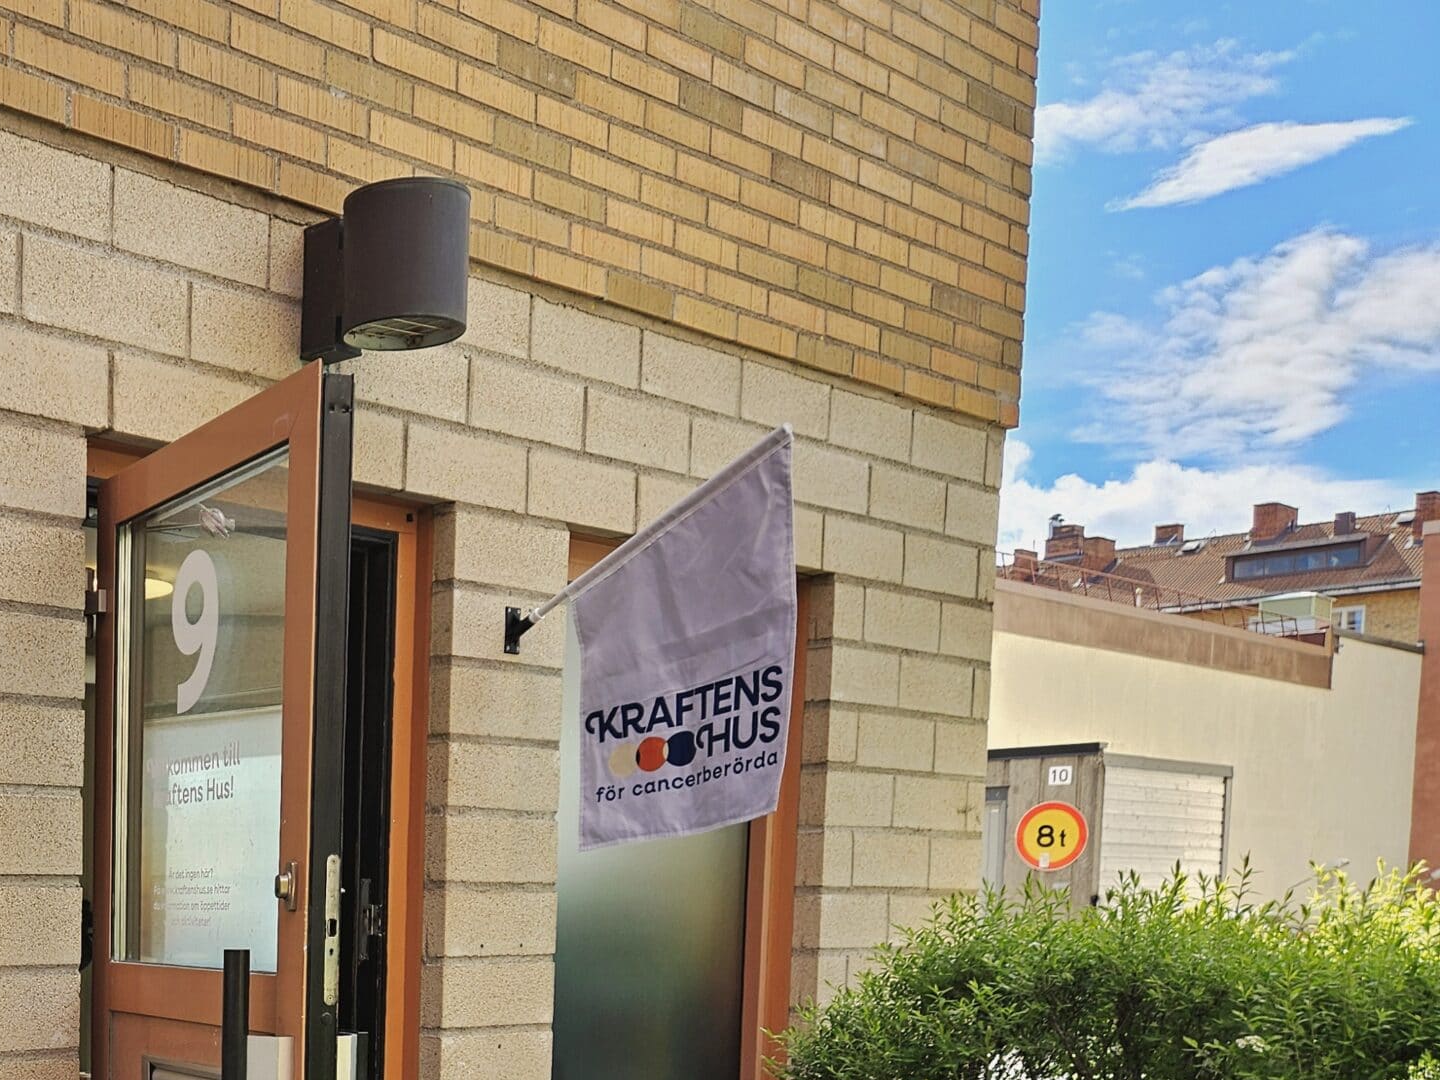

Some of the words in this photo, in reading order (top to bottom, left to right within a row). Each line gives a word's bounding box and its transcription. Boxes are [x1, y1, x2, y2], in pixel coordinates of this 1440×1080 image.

[171, 549, 219, 714] 9
[585, 665, 783, 743] KRAFTENS
[223, 740, 240, 767] till
[696, 706, 781, 757] HUS
[206, 775, 234, 801] Hus!
[596, 785, 625, 802] för
[632, 751, 778, 796] cancerberörda
[1051, 769, 1068, 782] 10
